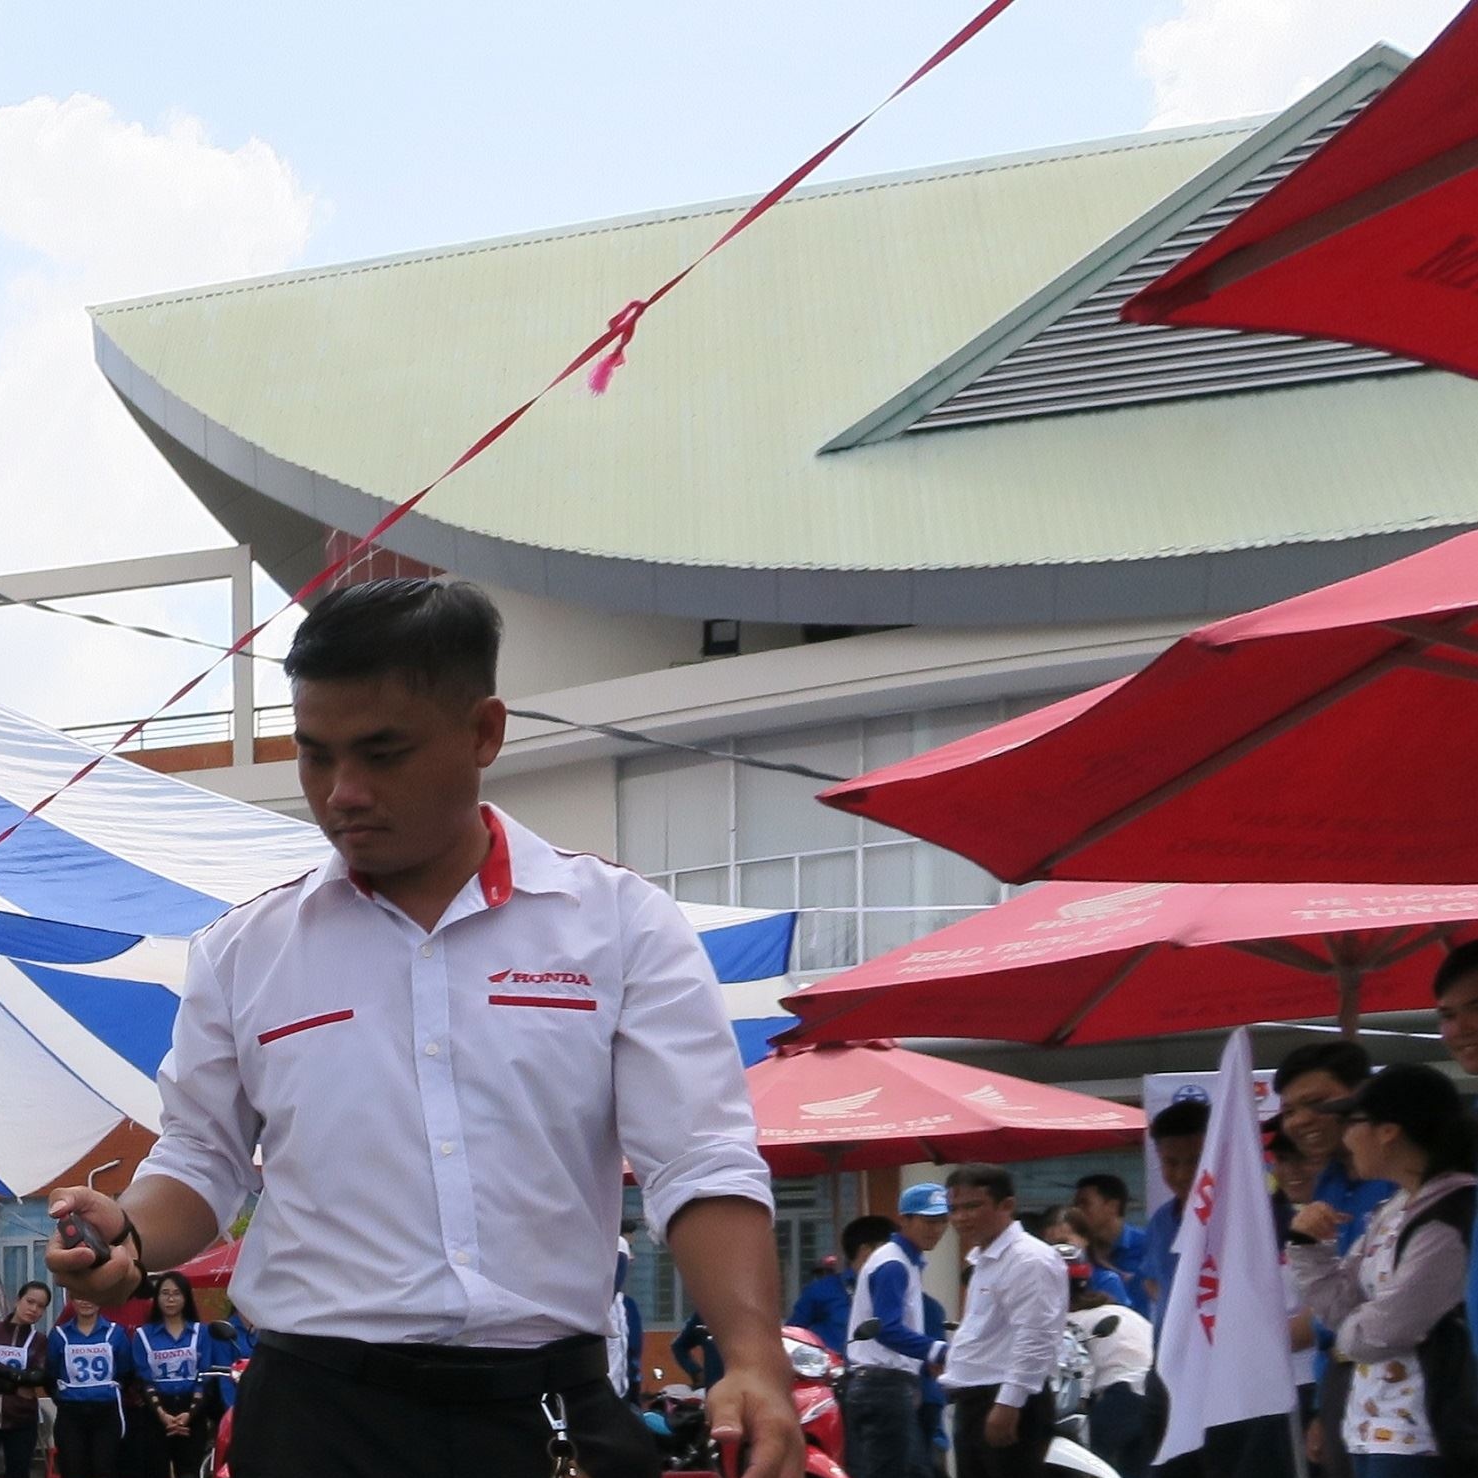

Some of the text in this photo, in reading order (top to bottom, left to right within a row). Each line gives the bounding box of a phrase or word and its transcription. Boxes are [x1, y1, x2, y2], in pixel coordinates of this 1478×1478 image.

[1291, 902, 1475, 921] TRUNG
[511, 971, 592, 986] HONDA
[760, 1128, 818, 1137] HEAD
[825, 1123, 897, 1133] TRUNG
[71, 1347, 108, 1355] HONDA
[154, 1350, 193, 1361] HONDA
[73, 1356, 110, 1382] 39
[157, 1361, 191, 1380] 14
